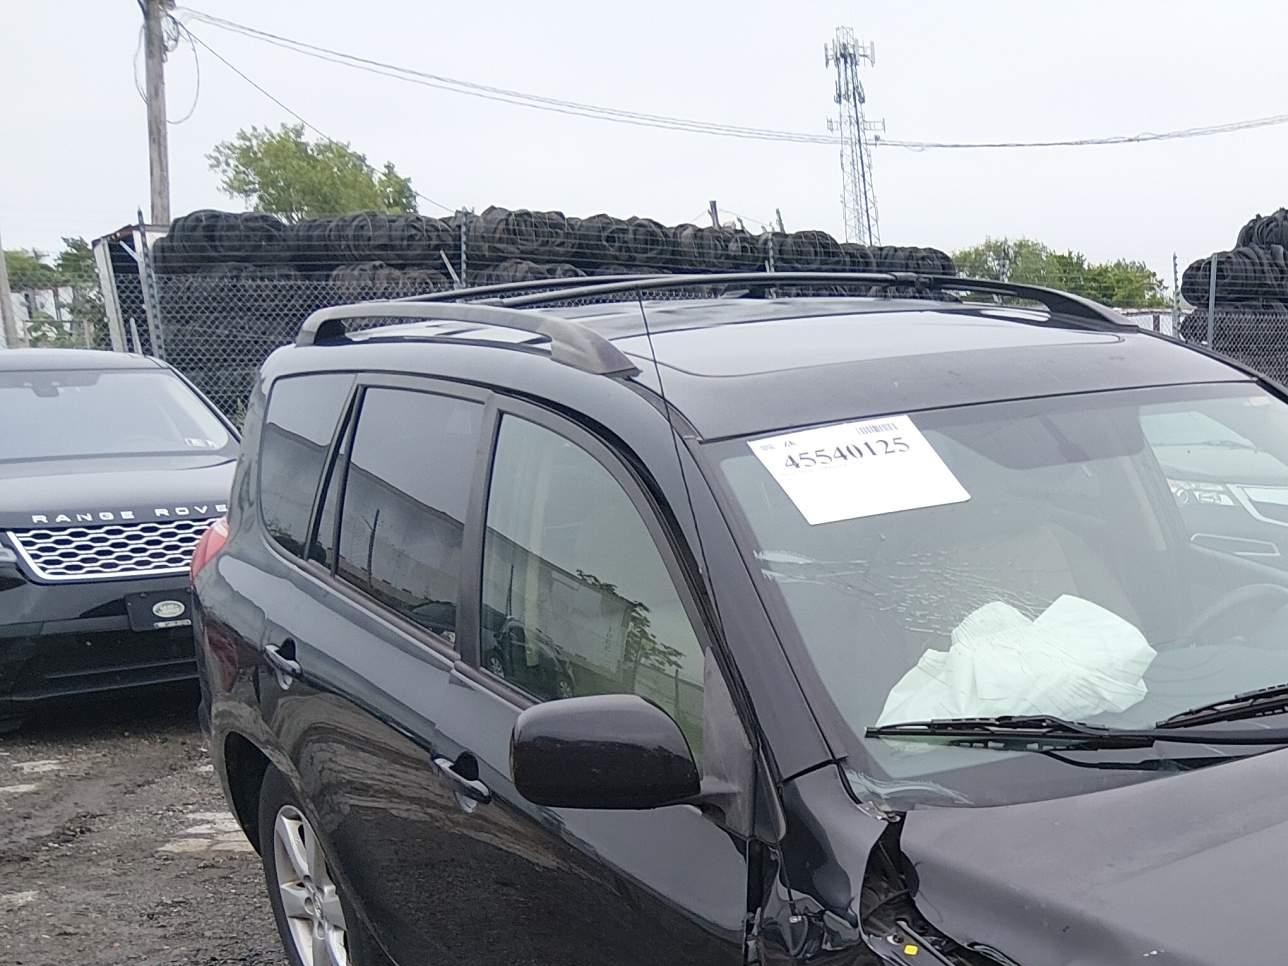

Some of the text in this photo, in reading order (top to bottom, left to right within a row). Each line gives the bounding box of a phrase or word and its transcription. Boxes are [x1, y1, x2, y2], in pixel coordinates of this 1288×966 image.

[785, 437, 911, 469] 45540125
[32, 503, 228, 524] RANGE ROVE
